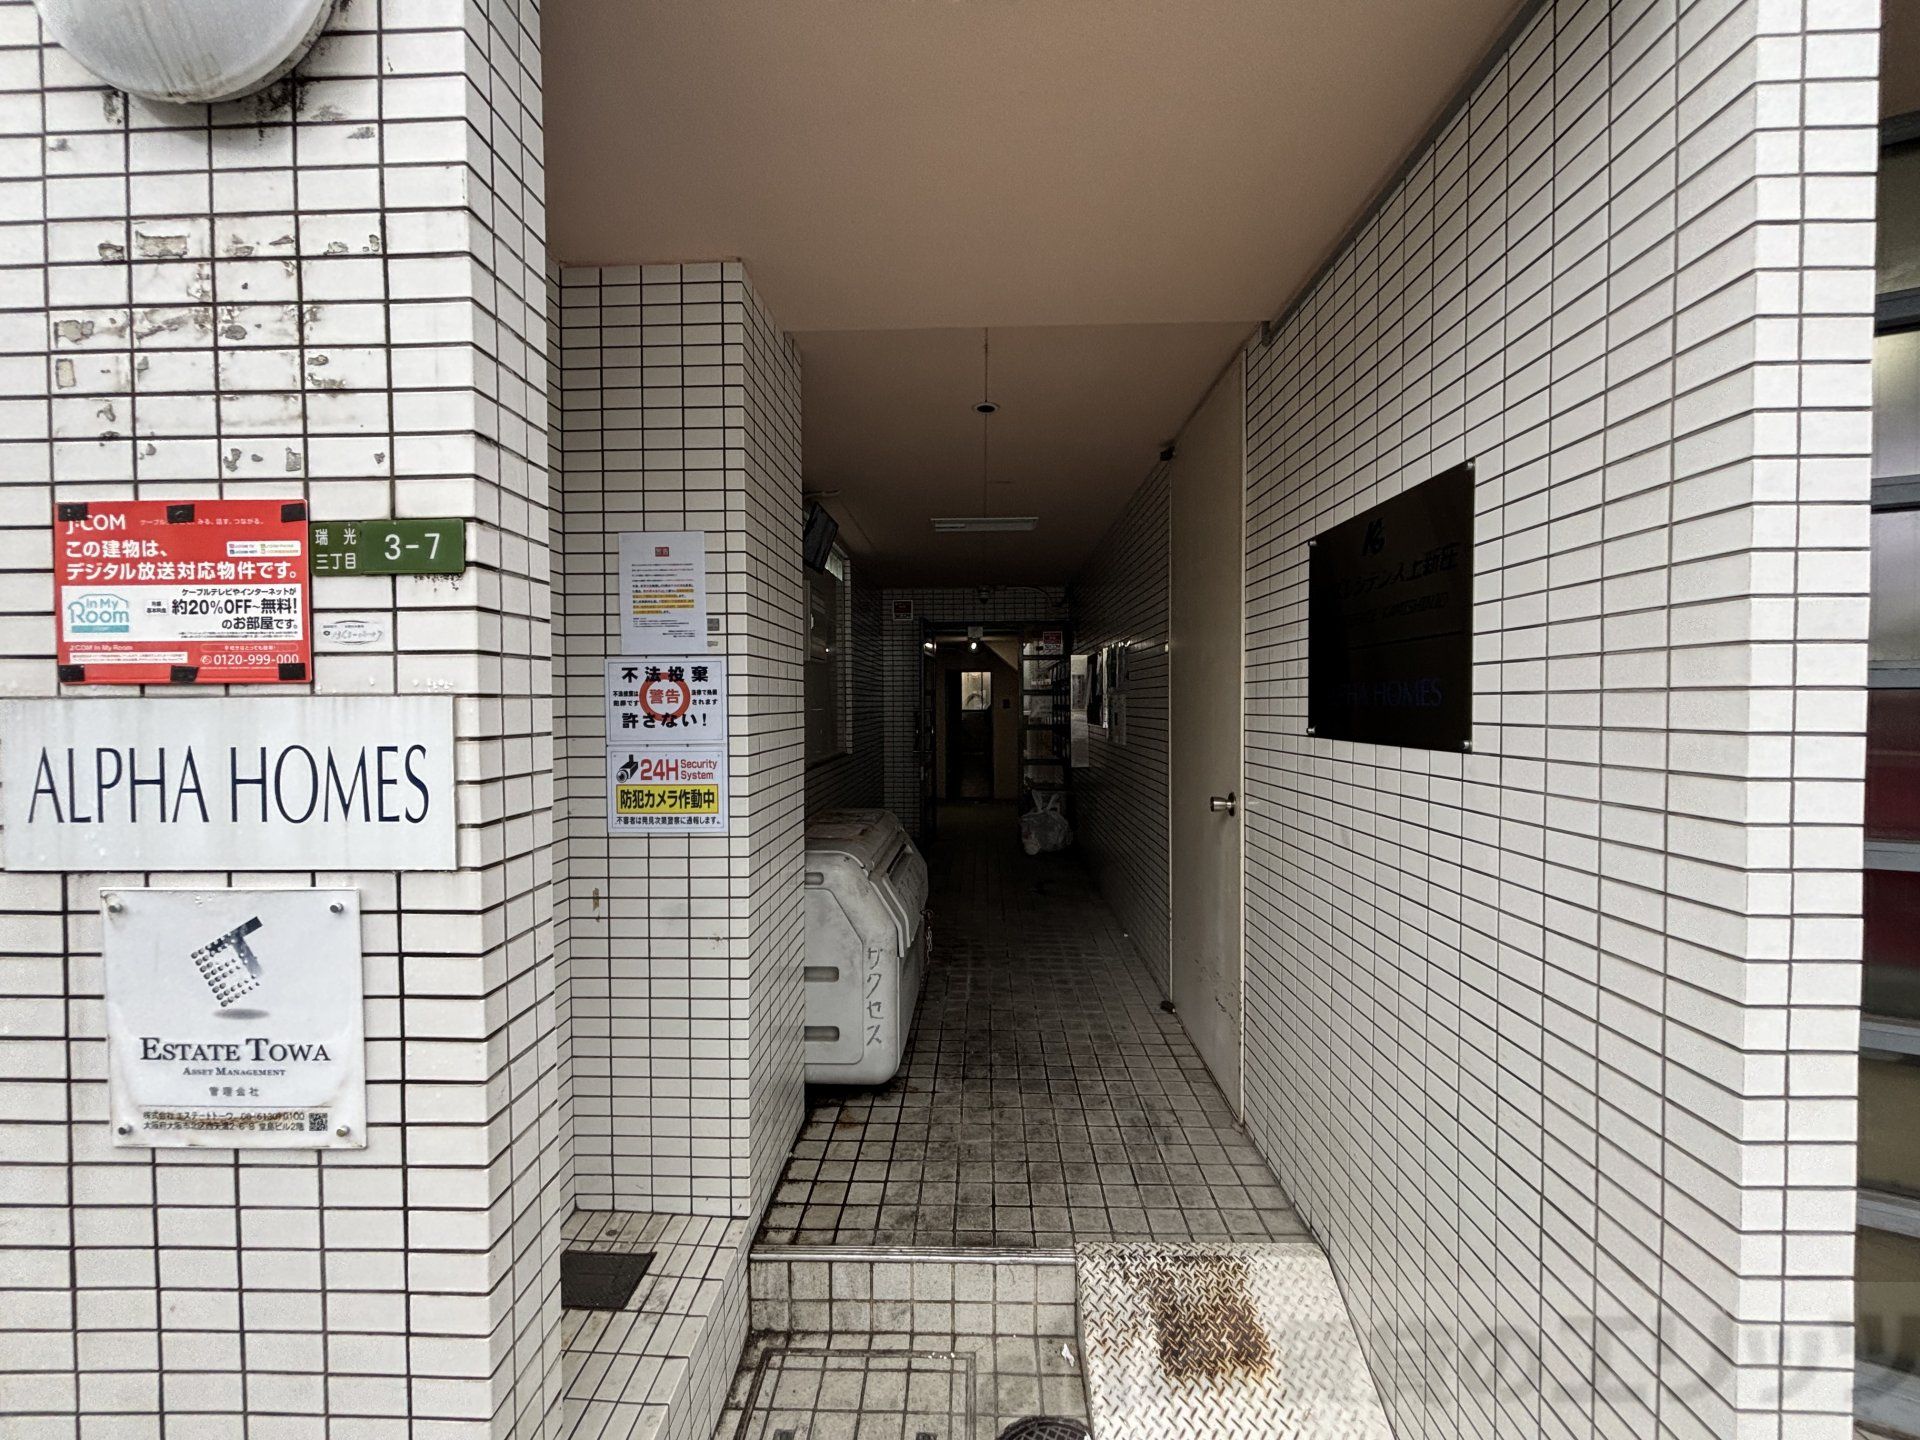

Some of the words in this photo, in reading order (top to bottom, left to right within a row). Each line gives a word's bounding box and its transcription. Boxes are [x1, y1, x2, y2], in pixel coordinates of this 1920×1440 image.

[315, 528, 357, 545] 瑞光
[66, 540, 168, 558] この建物は、
[384, 532, 440, 560] 3-7
[315, 552, 357, 570] 三丁目
[66, 562, 297, 580] デジタル放送対応物件です。
[181, 588, 297, 597] ケーブルテレビやインターネットが
[68, 601, 130, 623] Room
[100, 598, 118, 610] My
[221, 616, 297, 630] のお部屋です。
[214, 654, 299, 665] 0120-999-000
[622, 666, 709, 683] 不法投棄
[649, 688, 681, 705] 警告
[622, 713, 707, 729] 許さない!
[640, 759, 679, 781] 24H
[681, 759, 717, 769] Security
[681, 770, 714, 781] System
[28, 746, 211, 824] ALPHA
[231, 744, 430, 824] HOMES
[620, 789, 715, 809] 防犯カメラ作動中
[209, 1087, 260, 1097] 管理会社
